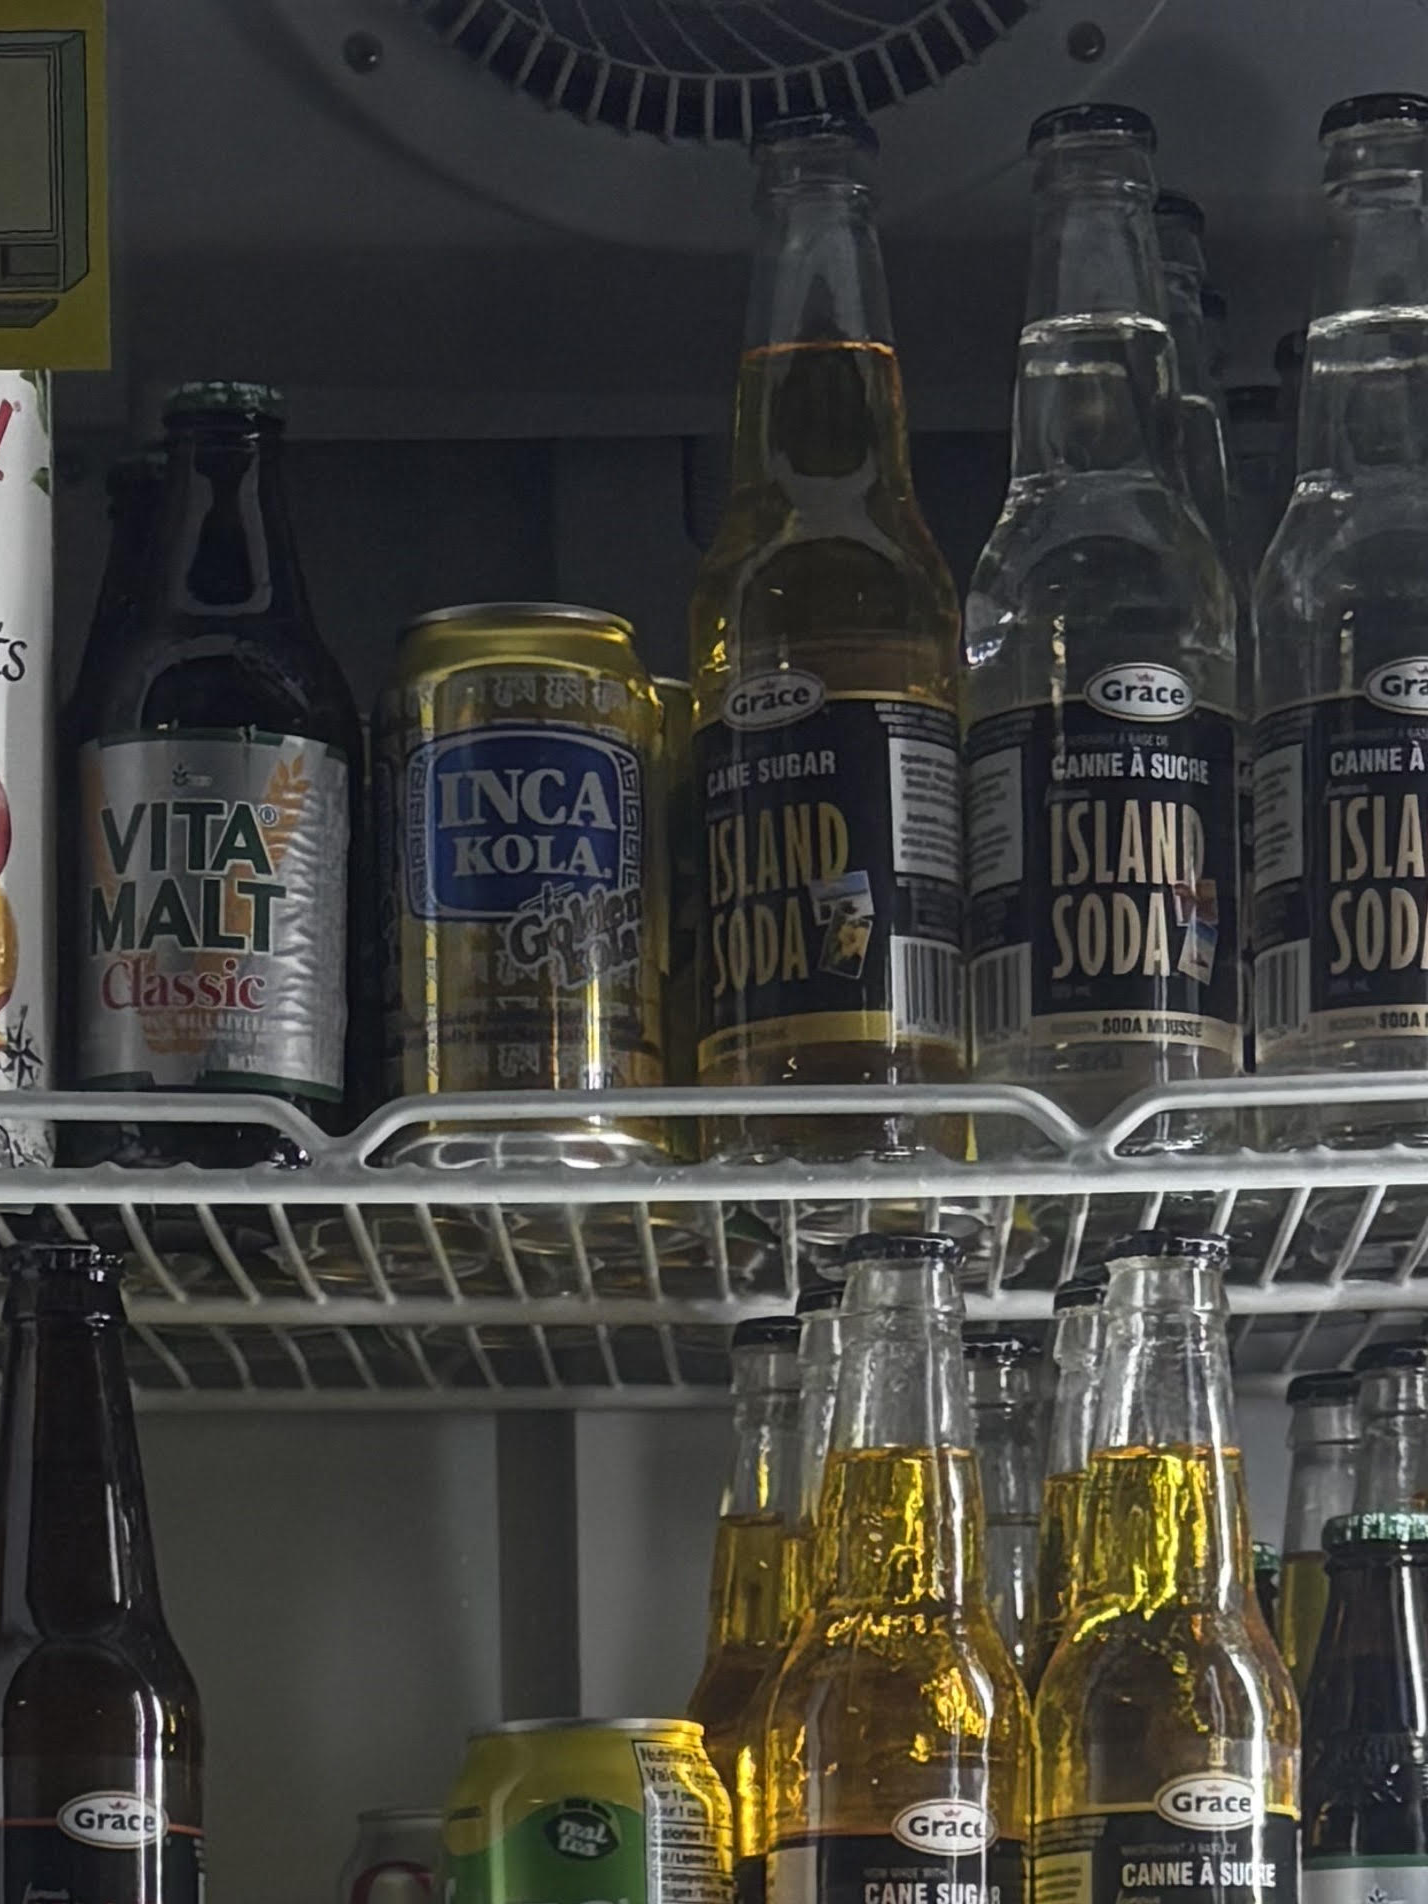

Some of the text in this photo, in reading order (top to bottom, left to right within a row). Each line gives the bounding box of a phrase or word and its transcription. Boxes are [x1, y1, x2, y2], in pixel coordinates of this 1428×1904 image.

[731, 682, 811, 716] Grace
[1100, 679, 1186, 706] Grace
[706, 749, 837, 799] CANE SUGAR
[1050, 744, 1212, 786] CANNE À SUCRE
[1329, 748, 1403, 778] CANNE
[1408, 740, 1426, 773] À
[437, 766, 618, 831] INCA
[100, 800, 273, 876] VITA
[709, 800, 851, 908] ISLAND
[1049, 798, 1206, 888] ISLAND
[90, 877, 288, 956] MALT
[1050, 891, 1172, 981] SODA
[712, 896, 810, 1001] SODA
[101, 958, 267, 1012] Classic
[73, 1807, 158, 1834] Grace
[907, 1815, 987, 1838] Grace
[1171, 1790, 1252, 1814] Grace
[1121, 1862, 1193, 1888] CANNE
[1200, 1855, 1215, 1887] À
